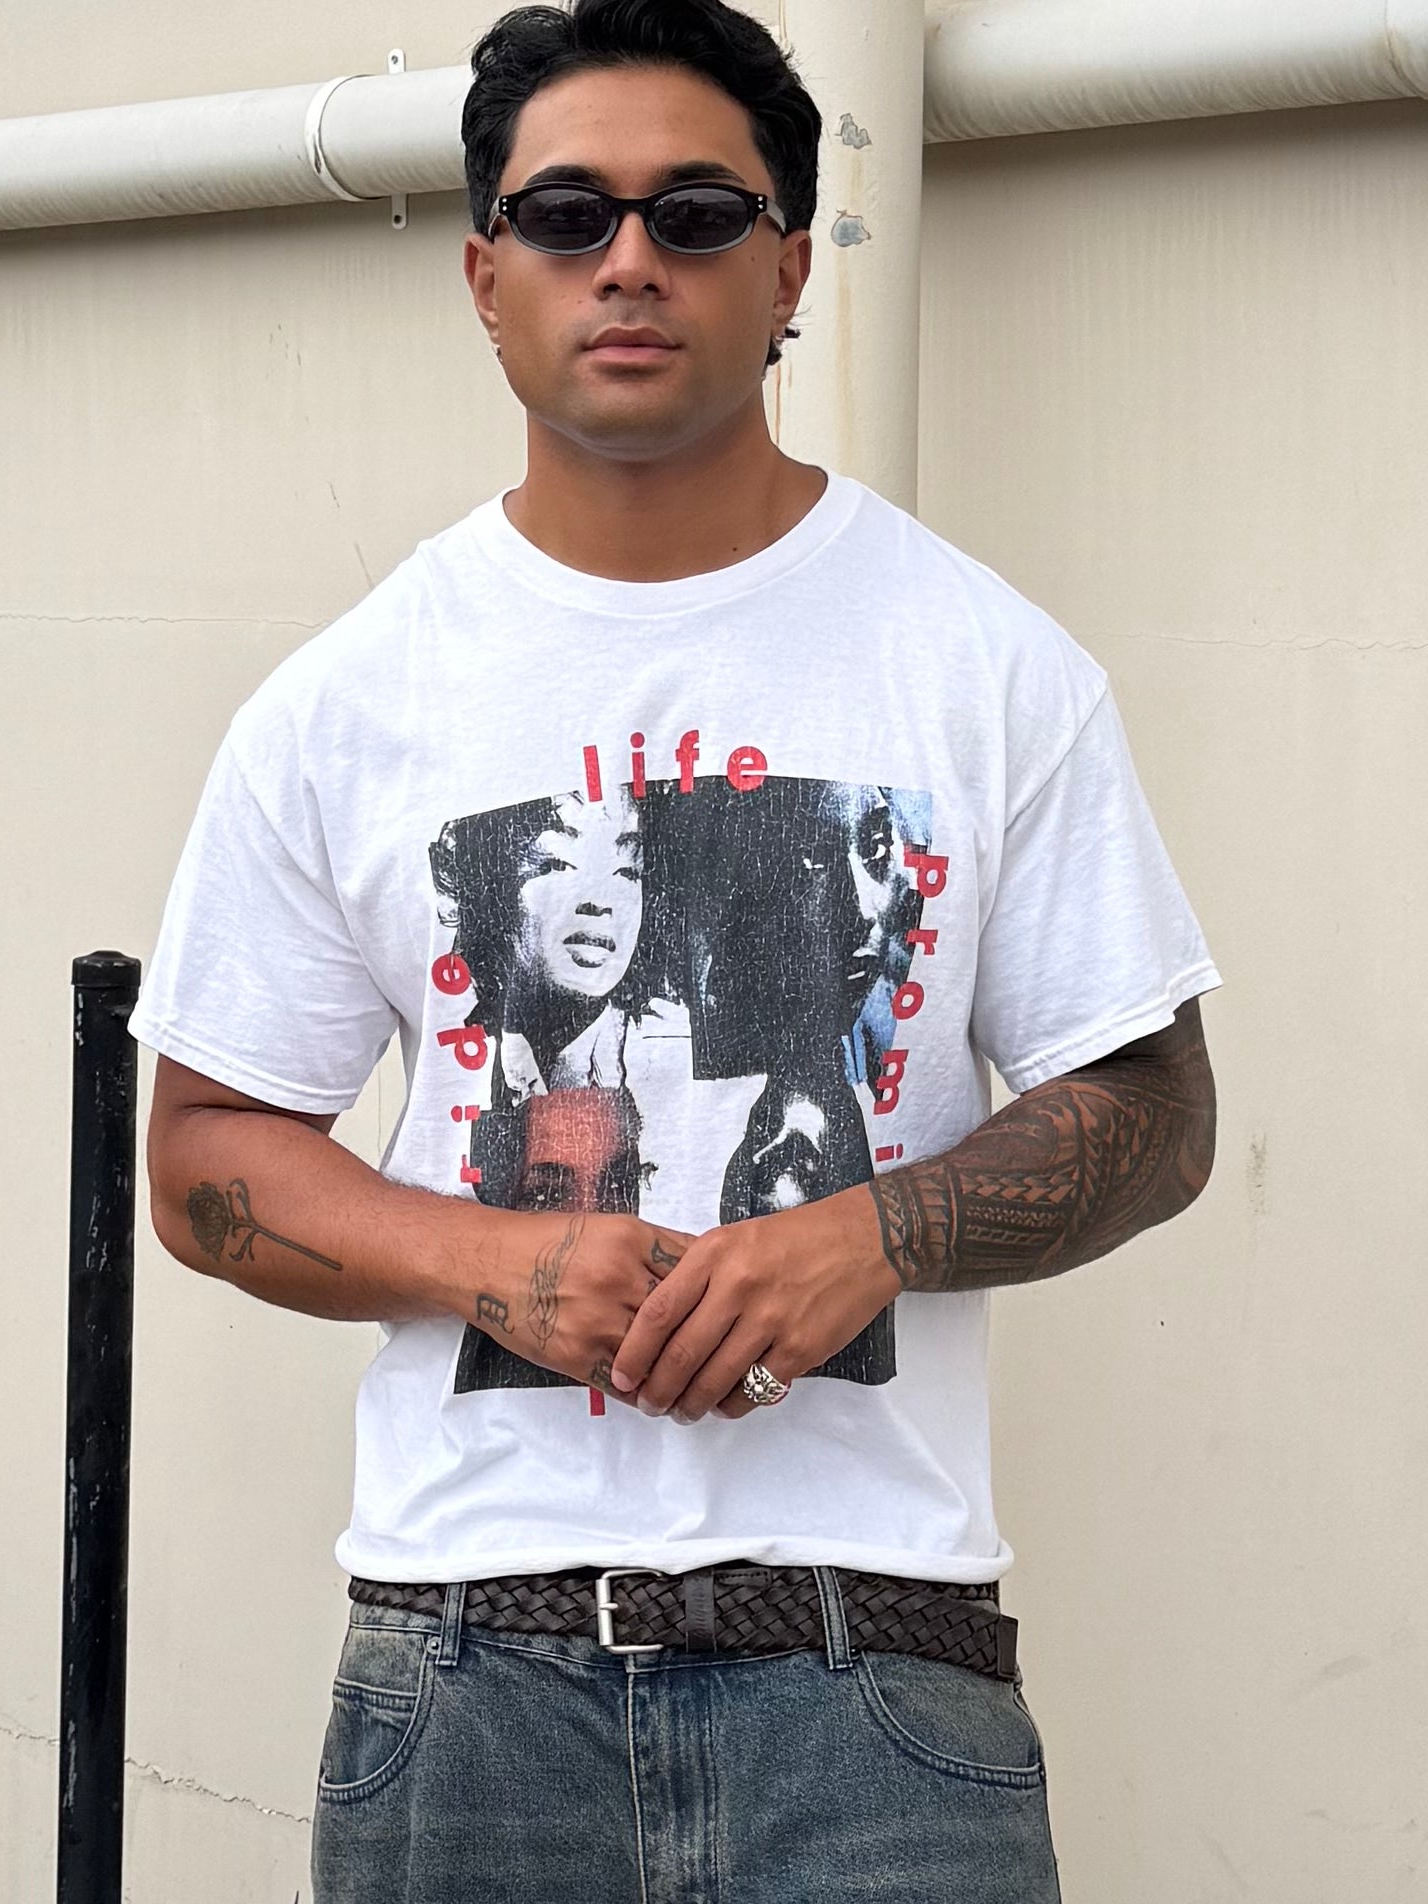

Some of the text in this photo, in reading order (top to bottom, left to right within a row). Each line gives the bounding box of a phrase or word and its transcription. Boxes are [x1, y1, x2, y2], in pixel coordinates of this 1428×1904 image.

[582, 729, 768, 803] life
[431, 953, 489, 1184] ride
[873, 847, 949, 1163] promi
